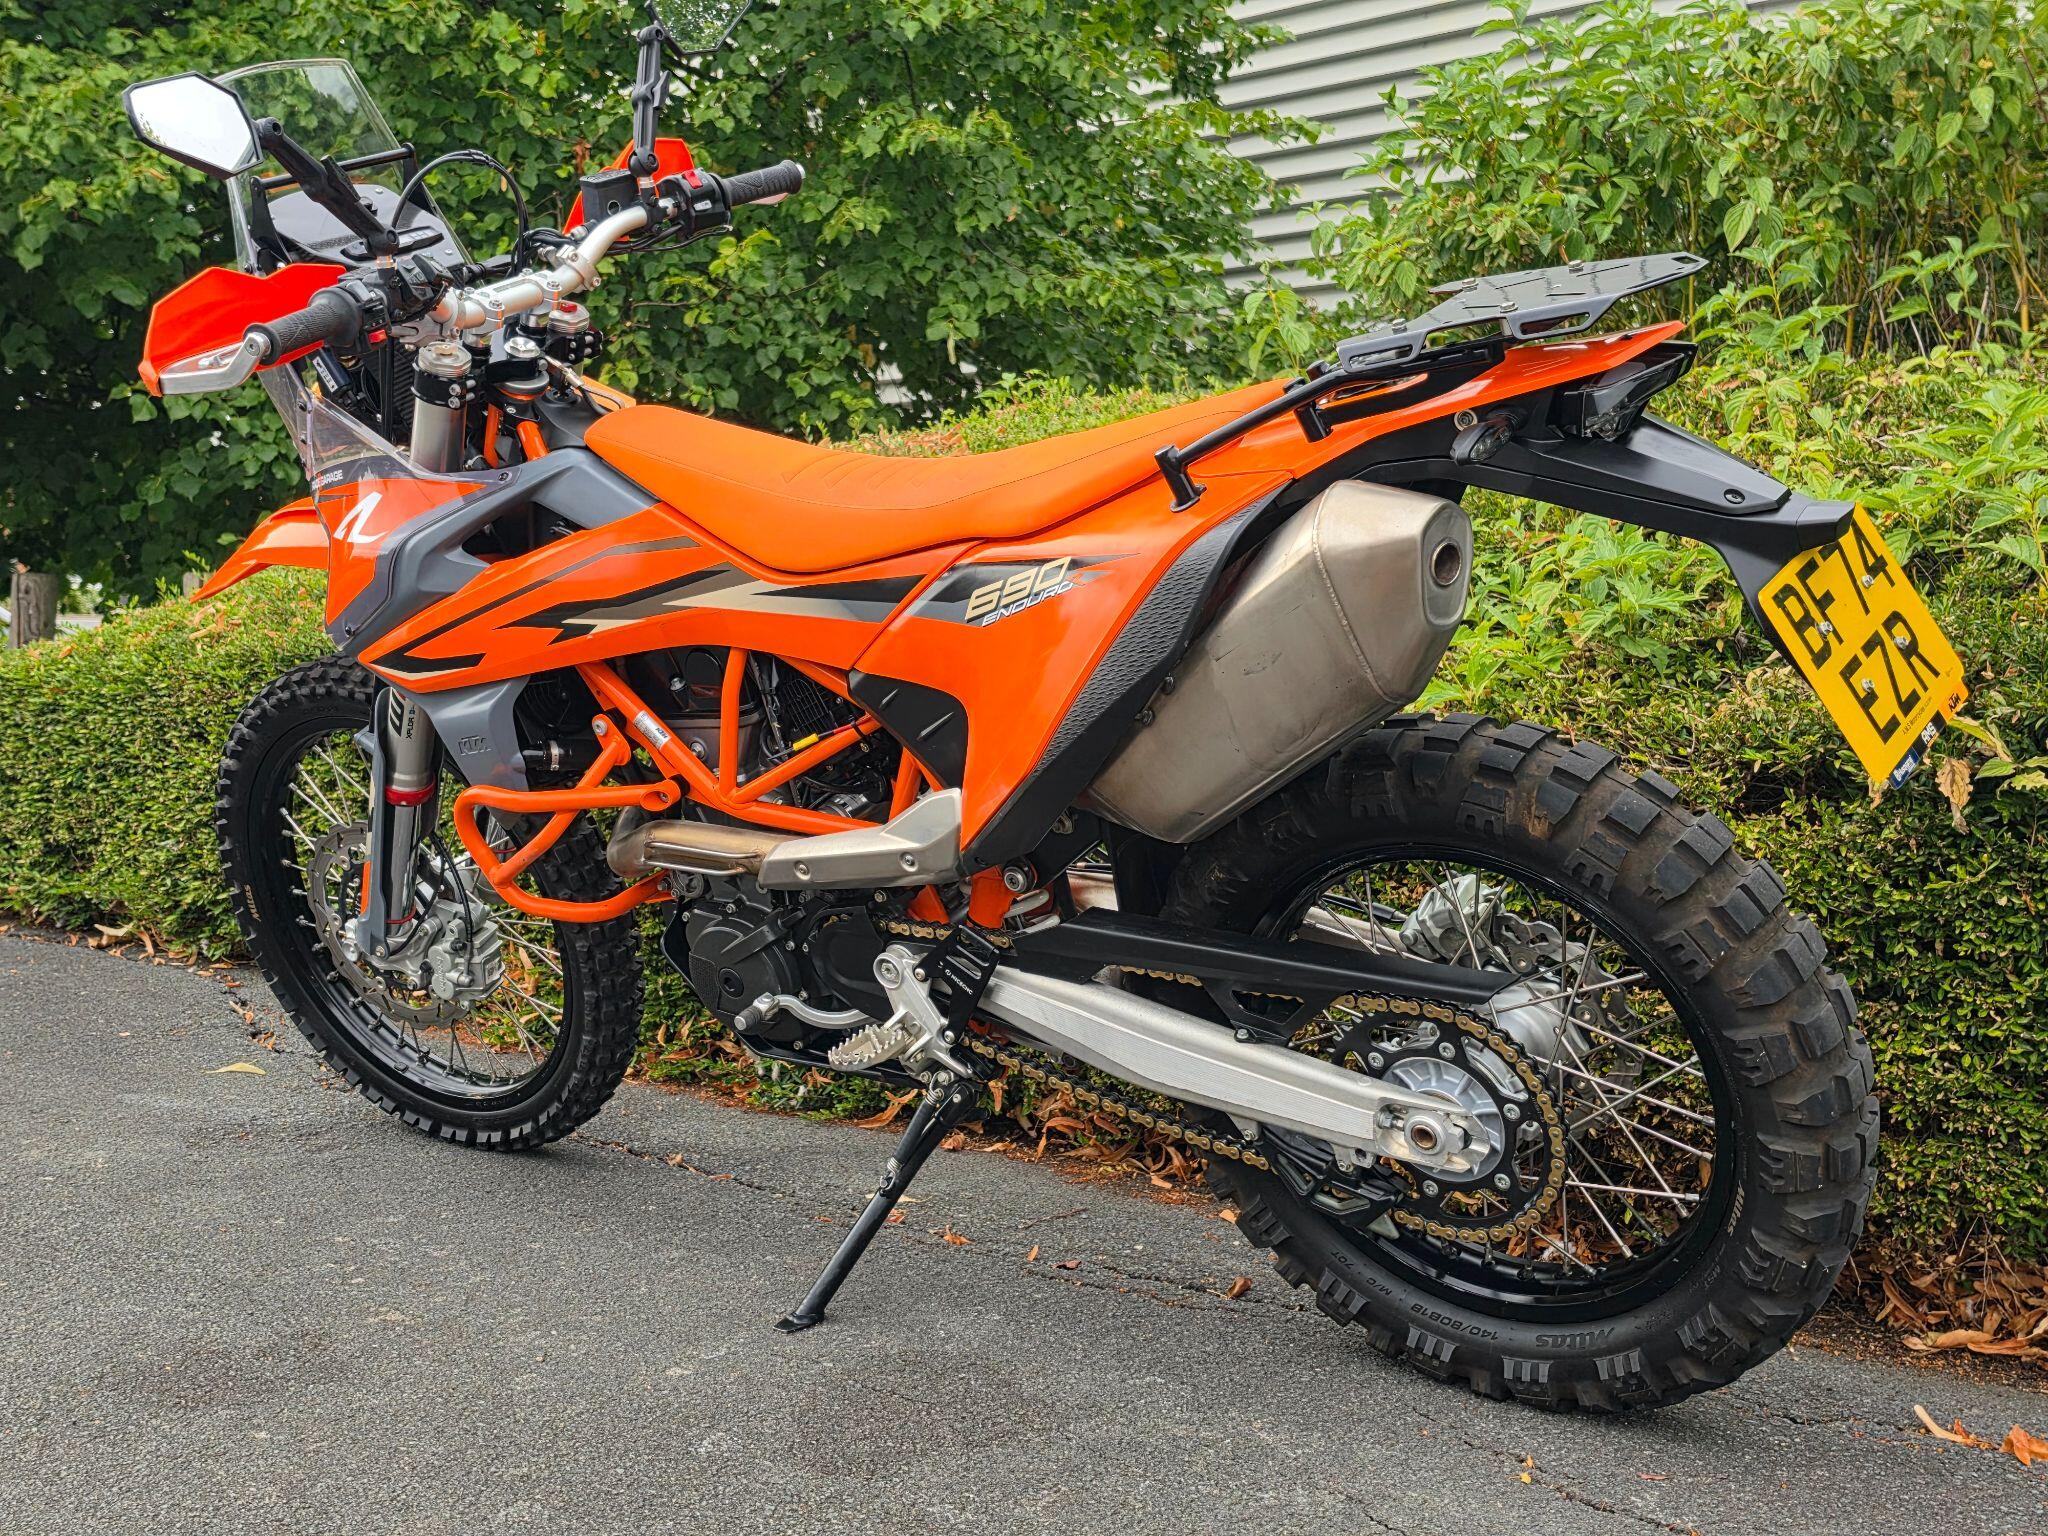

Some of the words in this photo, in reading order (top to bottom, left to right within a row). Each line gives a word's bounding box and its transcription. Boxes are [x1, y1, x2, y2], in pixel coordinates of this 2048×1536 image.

[965, 556, 1072, 623] 690
[982, 582, 1073, 627] ENDURO
[1771, 518, 1896, 671] BF74
[1839, 610, 1941, 745] EZR
[1366, 1277, 1393, 1297] M/C
[1535, 1326, 1616, 1350] Mitas
